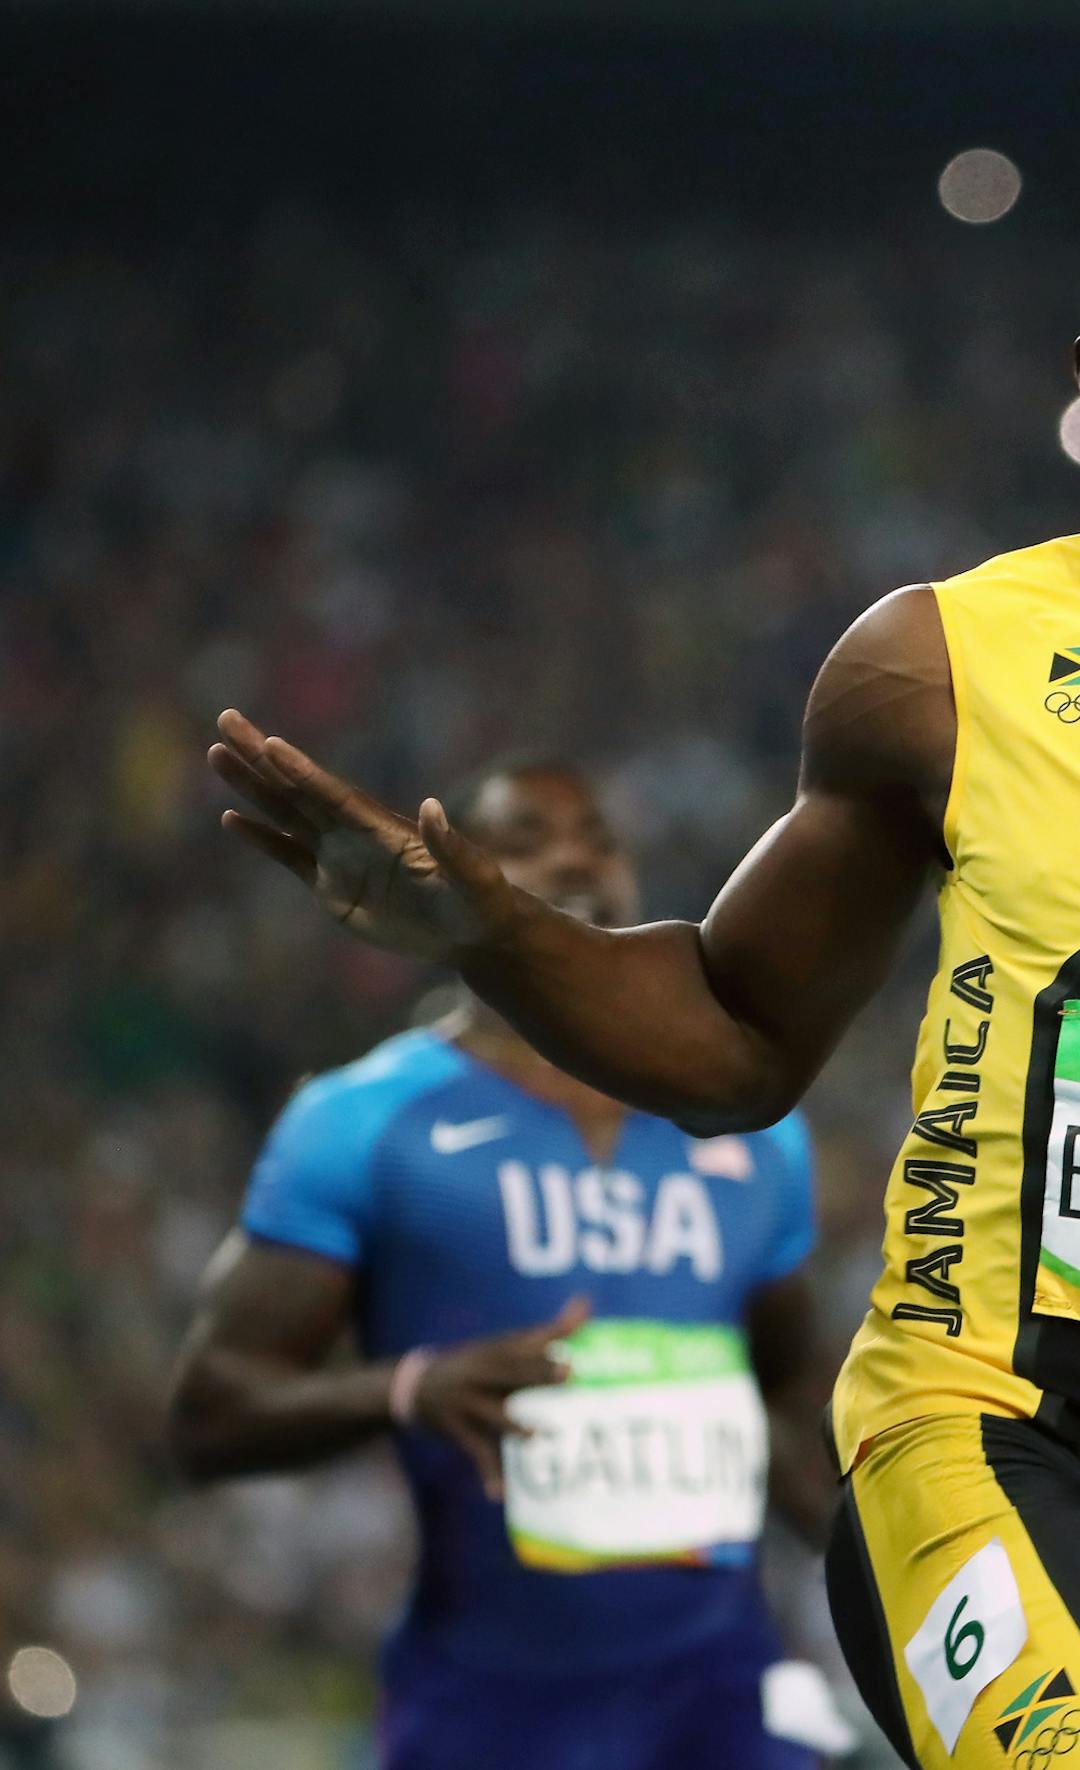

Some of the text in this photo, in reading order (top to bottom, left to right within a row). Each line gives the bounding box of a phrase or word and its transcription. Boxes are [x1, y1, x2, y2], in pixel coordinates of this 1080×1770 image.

[892, 954, 995, 1337] JAMAICA
[497, 1158, 724, 1284] USA
[944, 1594, 985, 1681] 6
